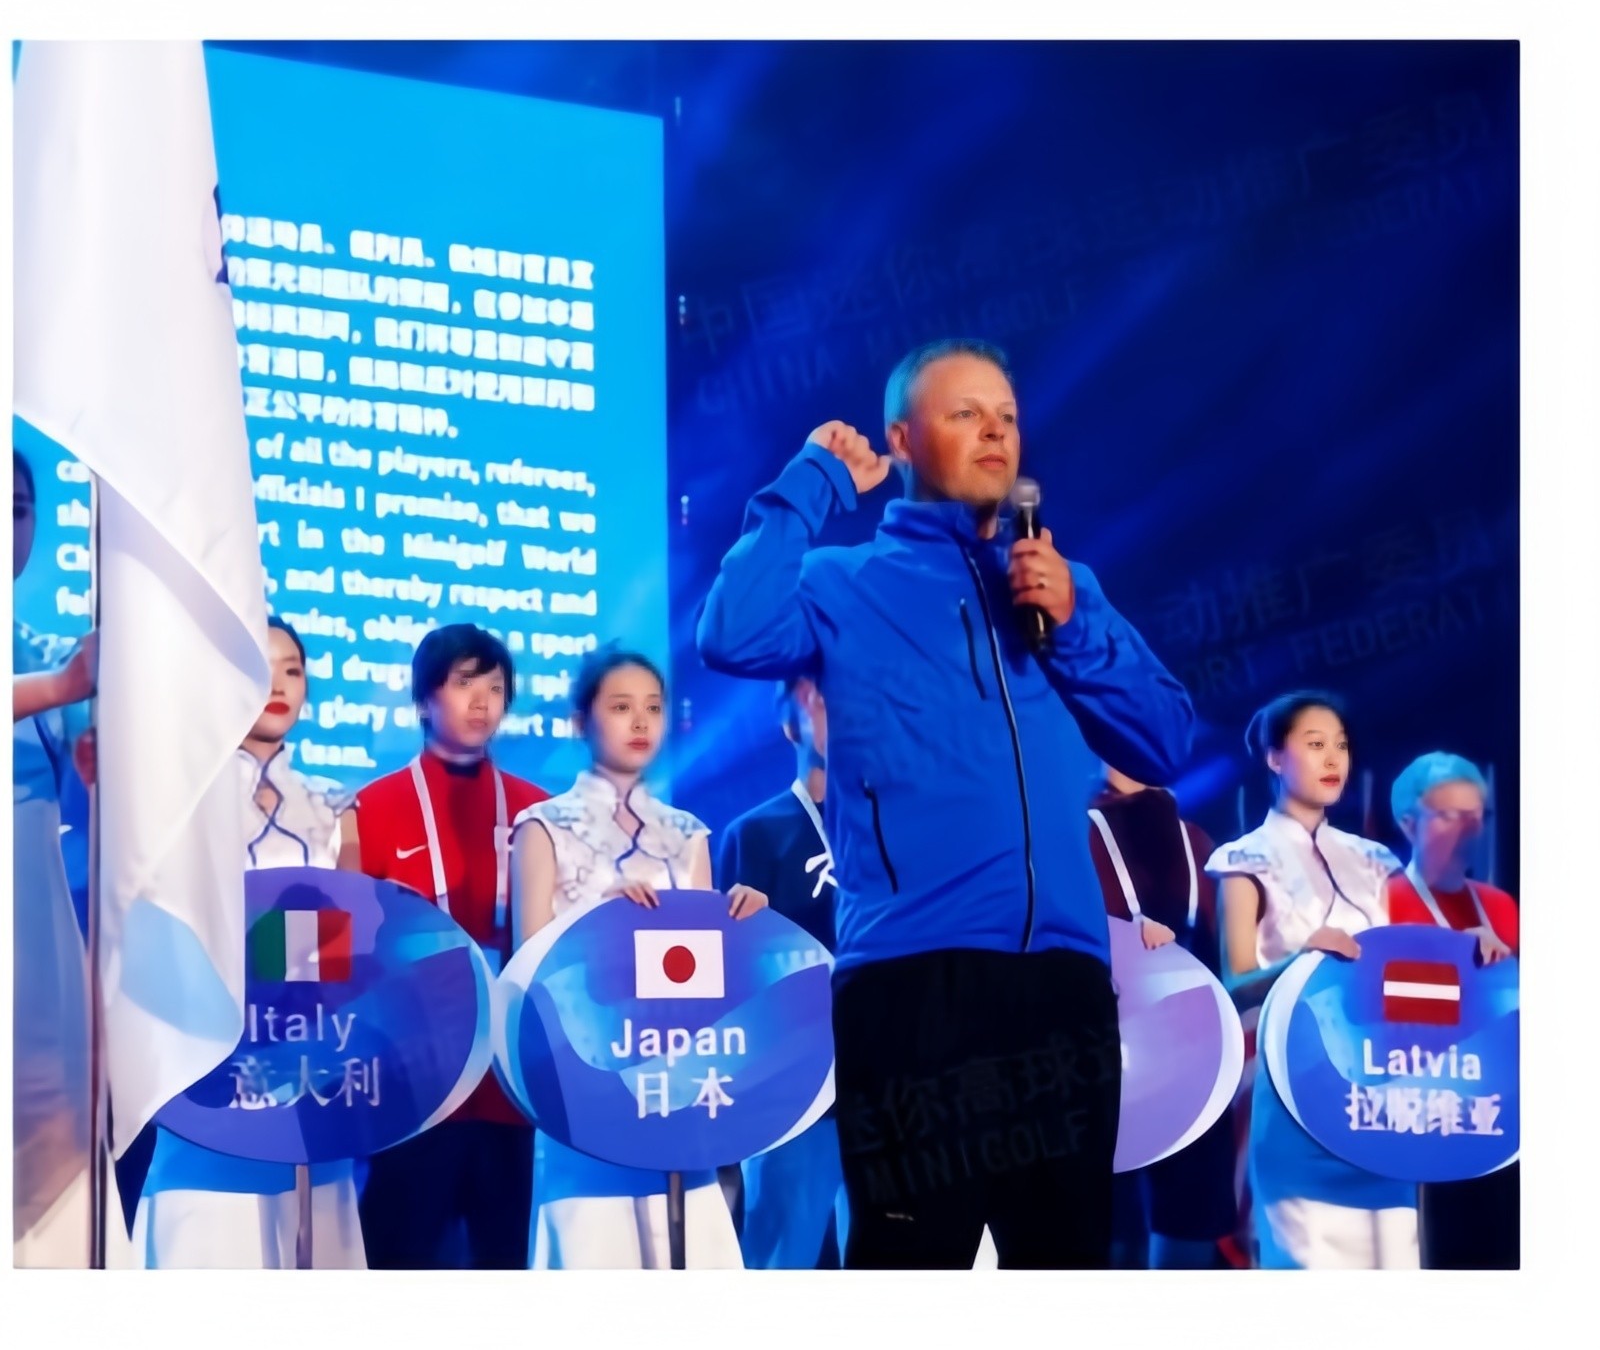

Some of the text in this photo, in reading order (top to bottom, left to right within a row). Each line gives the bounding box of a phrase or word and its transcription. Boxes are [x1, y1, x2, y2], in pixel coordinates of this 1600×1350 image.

[256, 432, 284, 459] of
[289, 436, 323, 465] all
[328, 441, 372, 470] the
[378, 446, 480, 485] players,
[375, 491, 488, 528] promise,
[496, 500, 550, 529] that
[559, 511, 596, 534] we
[298, 519, 324, 549] in
[341, 527, 385, 556] the
[403, 532, 507, 570] Minigolf
[521, 543, 597, 576] World
[285, 566, 335, 594] and
[342, 569, 443, 609] thereby
[449, 584, 543, 613] respect
[550, 589, 597, 616] and
[319, 695, 387, 731] glory
[246, 1003, 356, 1052] Italy
[610, 1018, 746, 1073] Japan
[228, 1055, 381, 1109] 意大利
[1362, 1038, 1482, 1080] Latvia
[636, 1067, 735, 1119] 日本
[1345, 1083, 1503, 1137] 拉脱维亚
